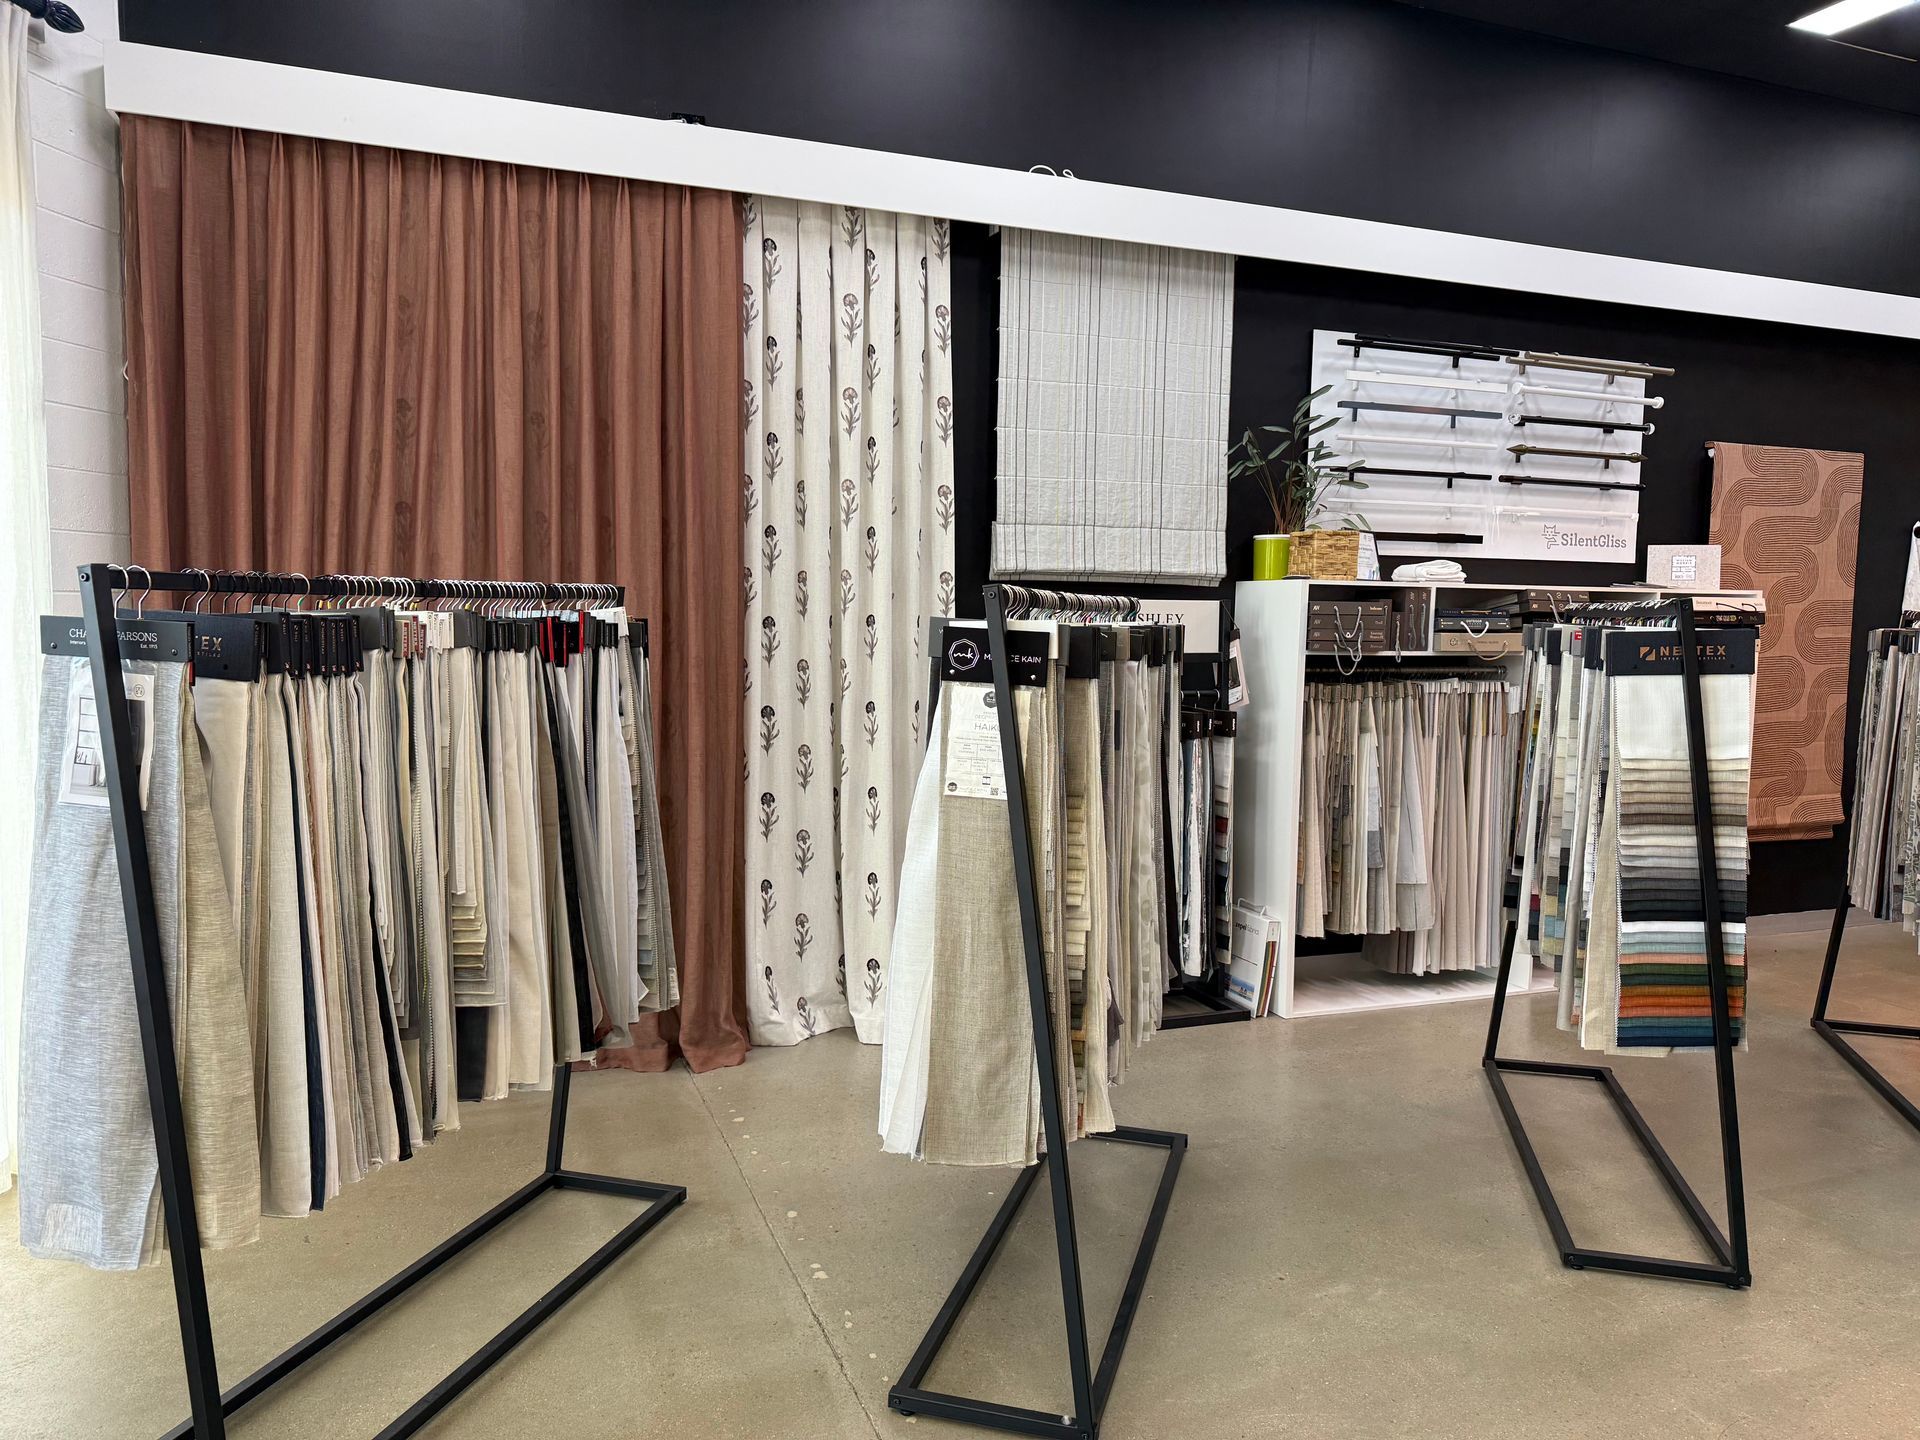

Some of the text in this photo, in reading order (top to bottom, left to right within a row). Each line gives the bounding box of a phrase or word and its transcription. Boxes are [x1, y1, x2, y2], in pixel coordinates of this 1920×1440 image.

[1561, 533, 1627, 548] SilentGliss
[1137, 613, 1185, 624] SHLEY
[1660, 645, 1726, 657] NETEX
[1021, 655, 1042, 663] KAIN
